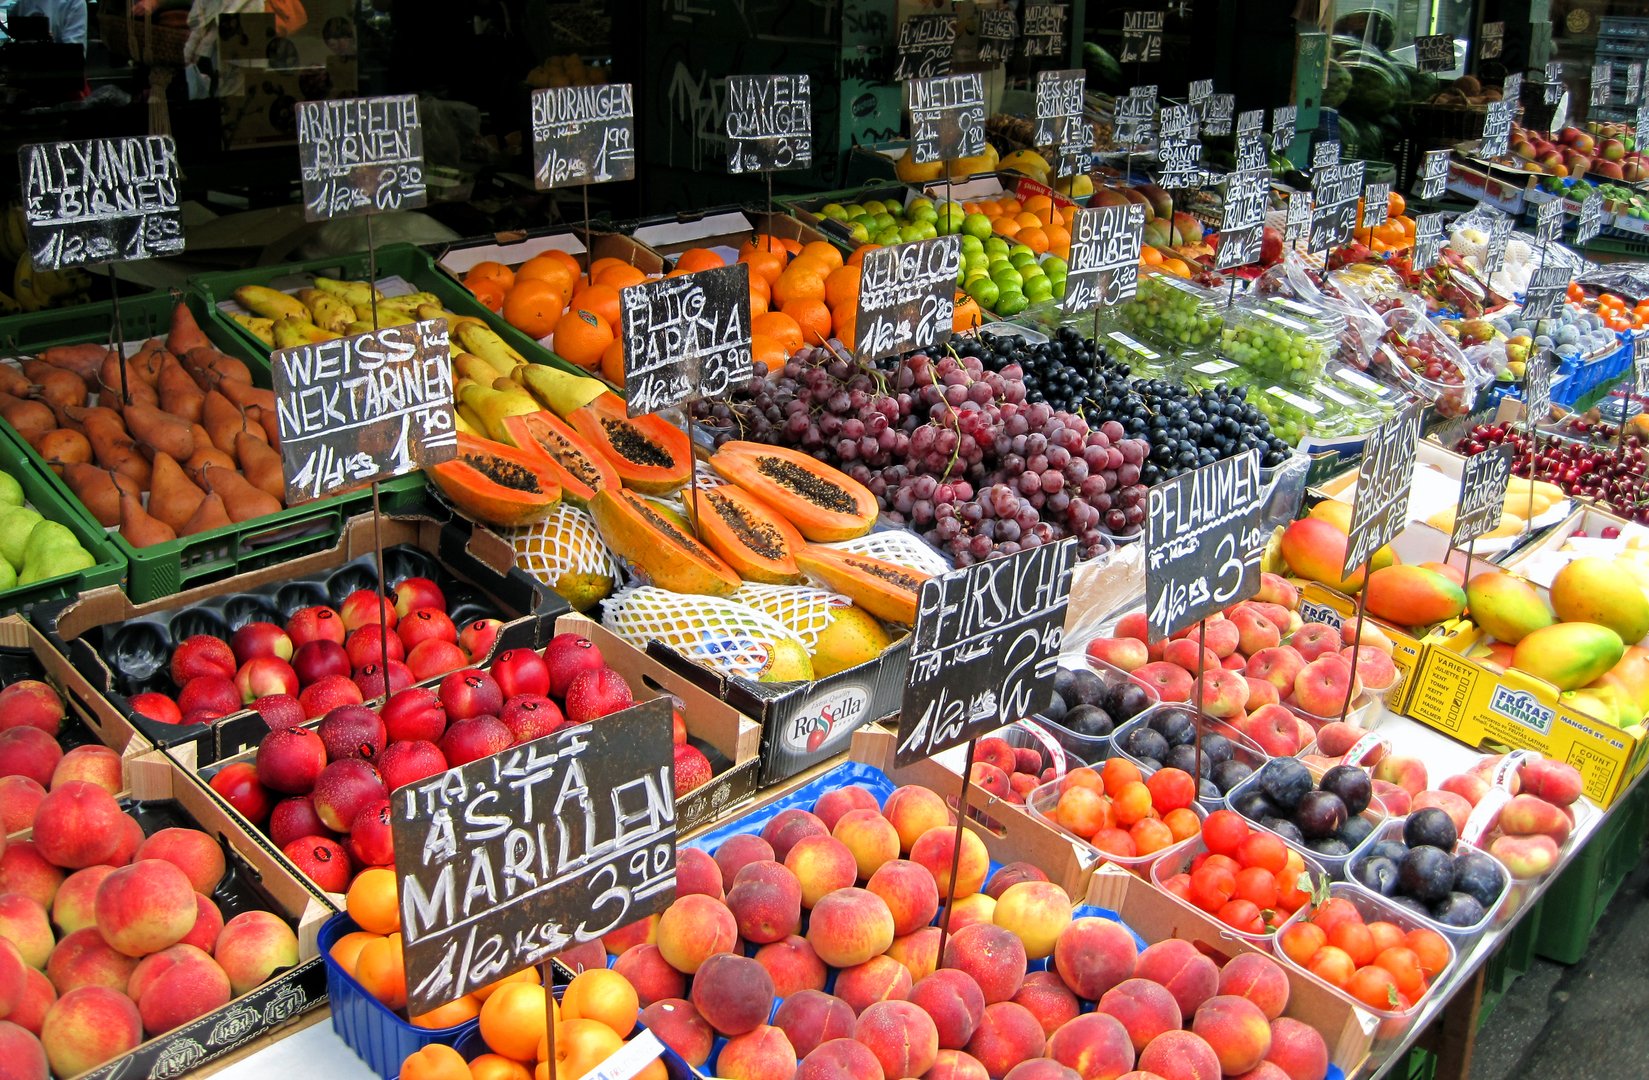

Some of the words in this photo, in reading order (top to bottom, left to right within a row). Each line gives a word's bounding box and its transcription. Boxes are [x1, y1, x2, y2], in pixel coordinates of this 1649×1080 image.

[730, 77, 806, 111] NAVEL
[909, 73, 983, 110] LIMETTEN
[1036, 97, 1083, 118] ORANGEN
[726, 104, 812, 137] ORANGEN
[1161, 105, 1188, 123] BABY
[28, 136, 179, 197] ALEXANDER
[315, 130, 411, 169] BIRNEN
[1158, 144, 1202, 162] GRANAT
[1236, 152, 1266, 172] PAPAYA
[58, 178, 177, 218] BIRNEN
[1070, 227, 1142, 270] TRAUBEN
[629, 286, 706, 338] FLUG
[631, 303, 743, 370] PAPAYA
[281, 329, 418, 387] WEISS
[277, 352, 455, 437] NEKTARINEN
[1358, 408, 1423, 496] SATURN
[1464, 457, 1507, 493] FLUG
[1149, 449, 1260, 544] PFLAUMEN
[1460, 474, 1508, 515] MANGOS
[912, 538, 1078, 655] PFIRSICHE
[1302, 605, 1341, 629] FRUTA
[1403, 646, 1416, 656] AIR
[1437, 656, 1473, 677] VARIETY
[1430, 680, 1450, 692] TOMMY
[1432, 673, 1447, 682] KENT
[1434, 665, 1459, 680] JULIETTE
[1419, 708, 1442, 721] PALMER
[1495, 699, 1546, 729] LATINAS
[1499, 690, 1549, 721] FRUTAS
[1528, 737, 1549, 750] LATINAS
[1560, 715, 1593, 735] MANGOS
[1594, 731, 1604, 740] BY
[1610, 740, 1624, 749] AIR
[1580, 749, 1611, 767] COUNT
[423, 757, 594, 867] ASTA
[402, 766, 674, 943] MARILLEN
